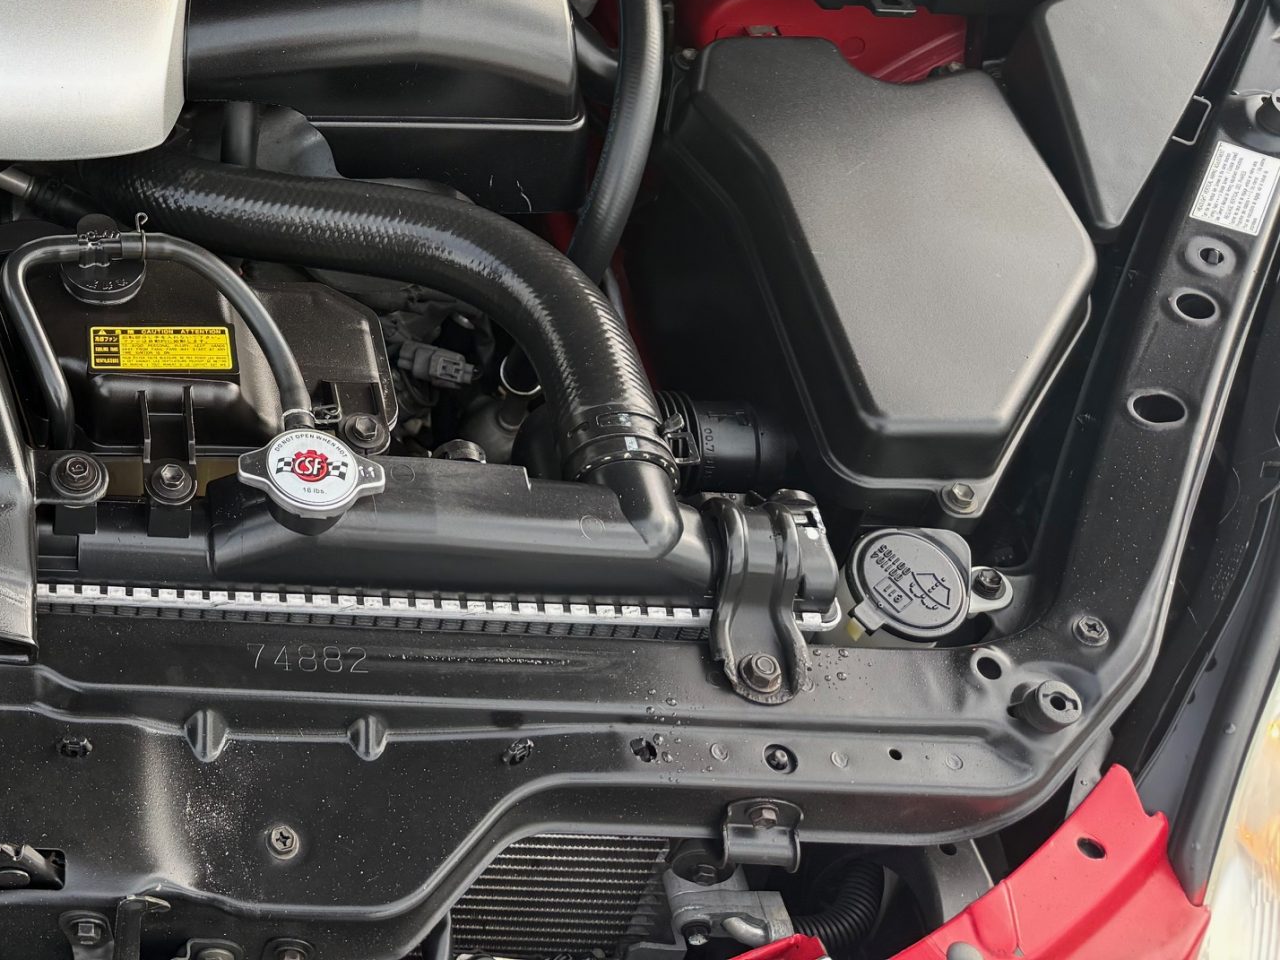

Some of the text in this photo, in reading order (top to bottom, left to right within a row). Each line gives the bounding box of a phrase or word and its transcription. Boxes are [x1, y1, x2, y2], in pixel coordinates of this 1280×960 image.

[281, 435, 294, 445] NOT
[316, 435, 336, 447] WHEN
[335, 445, 348, 458] HOT
[294, 455, 322, 475] CSF
[246, 642, 369, 673] 74882
